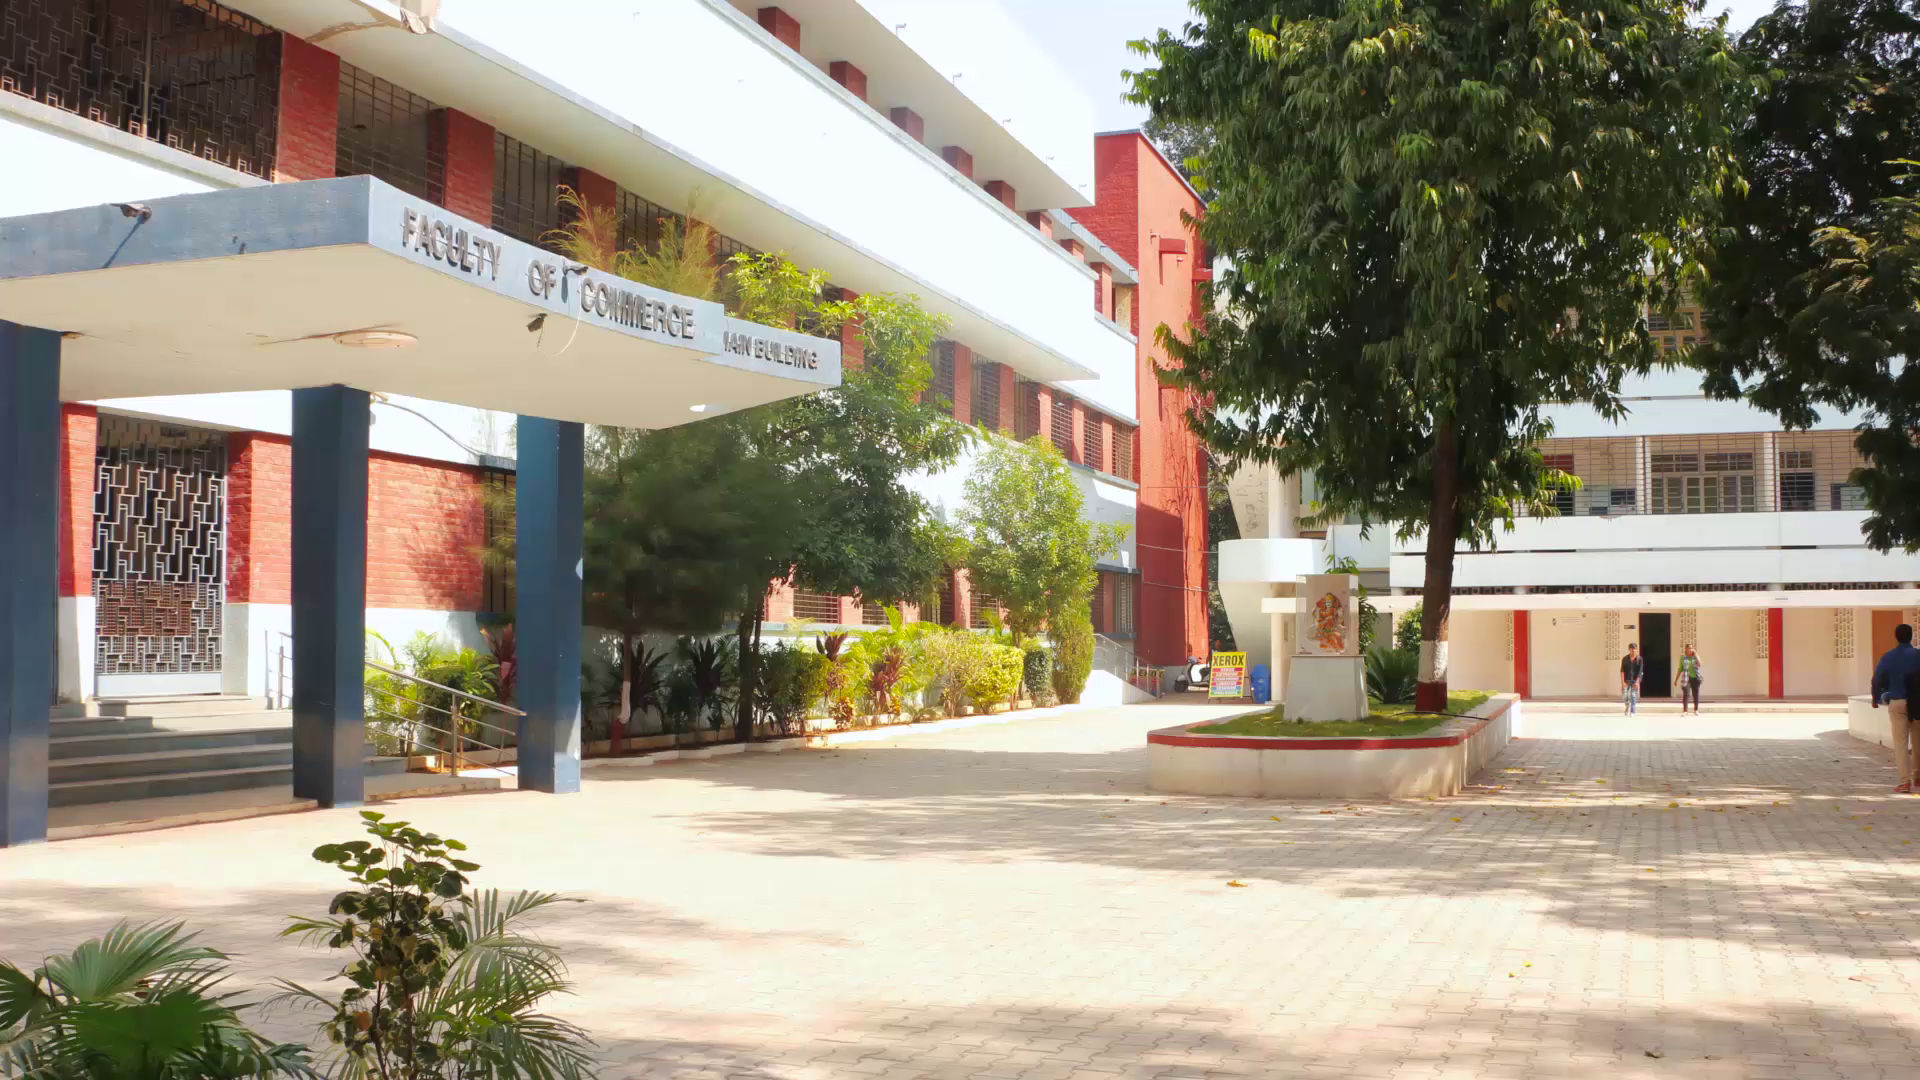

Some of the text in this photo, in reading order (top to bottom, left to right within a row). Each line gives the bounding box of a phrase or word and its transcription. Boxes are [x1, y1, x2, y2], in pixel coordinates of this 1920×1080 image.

[403, 206, 694, 339] FACULTY OF COMMERCE
[754, 338, 818, 370] BUILDING
[1213, 655, 1245, 667] XEROX
